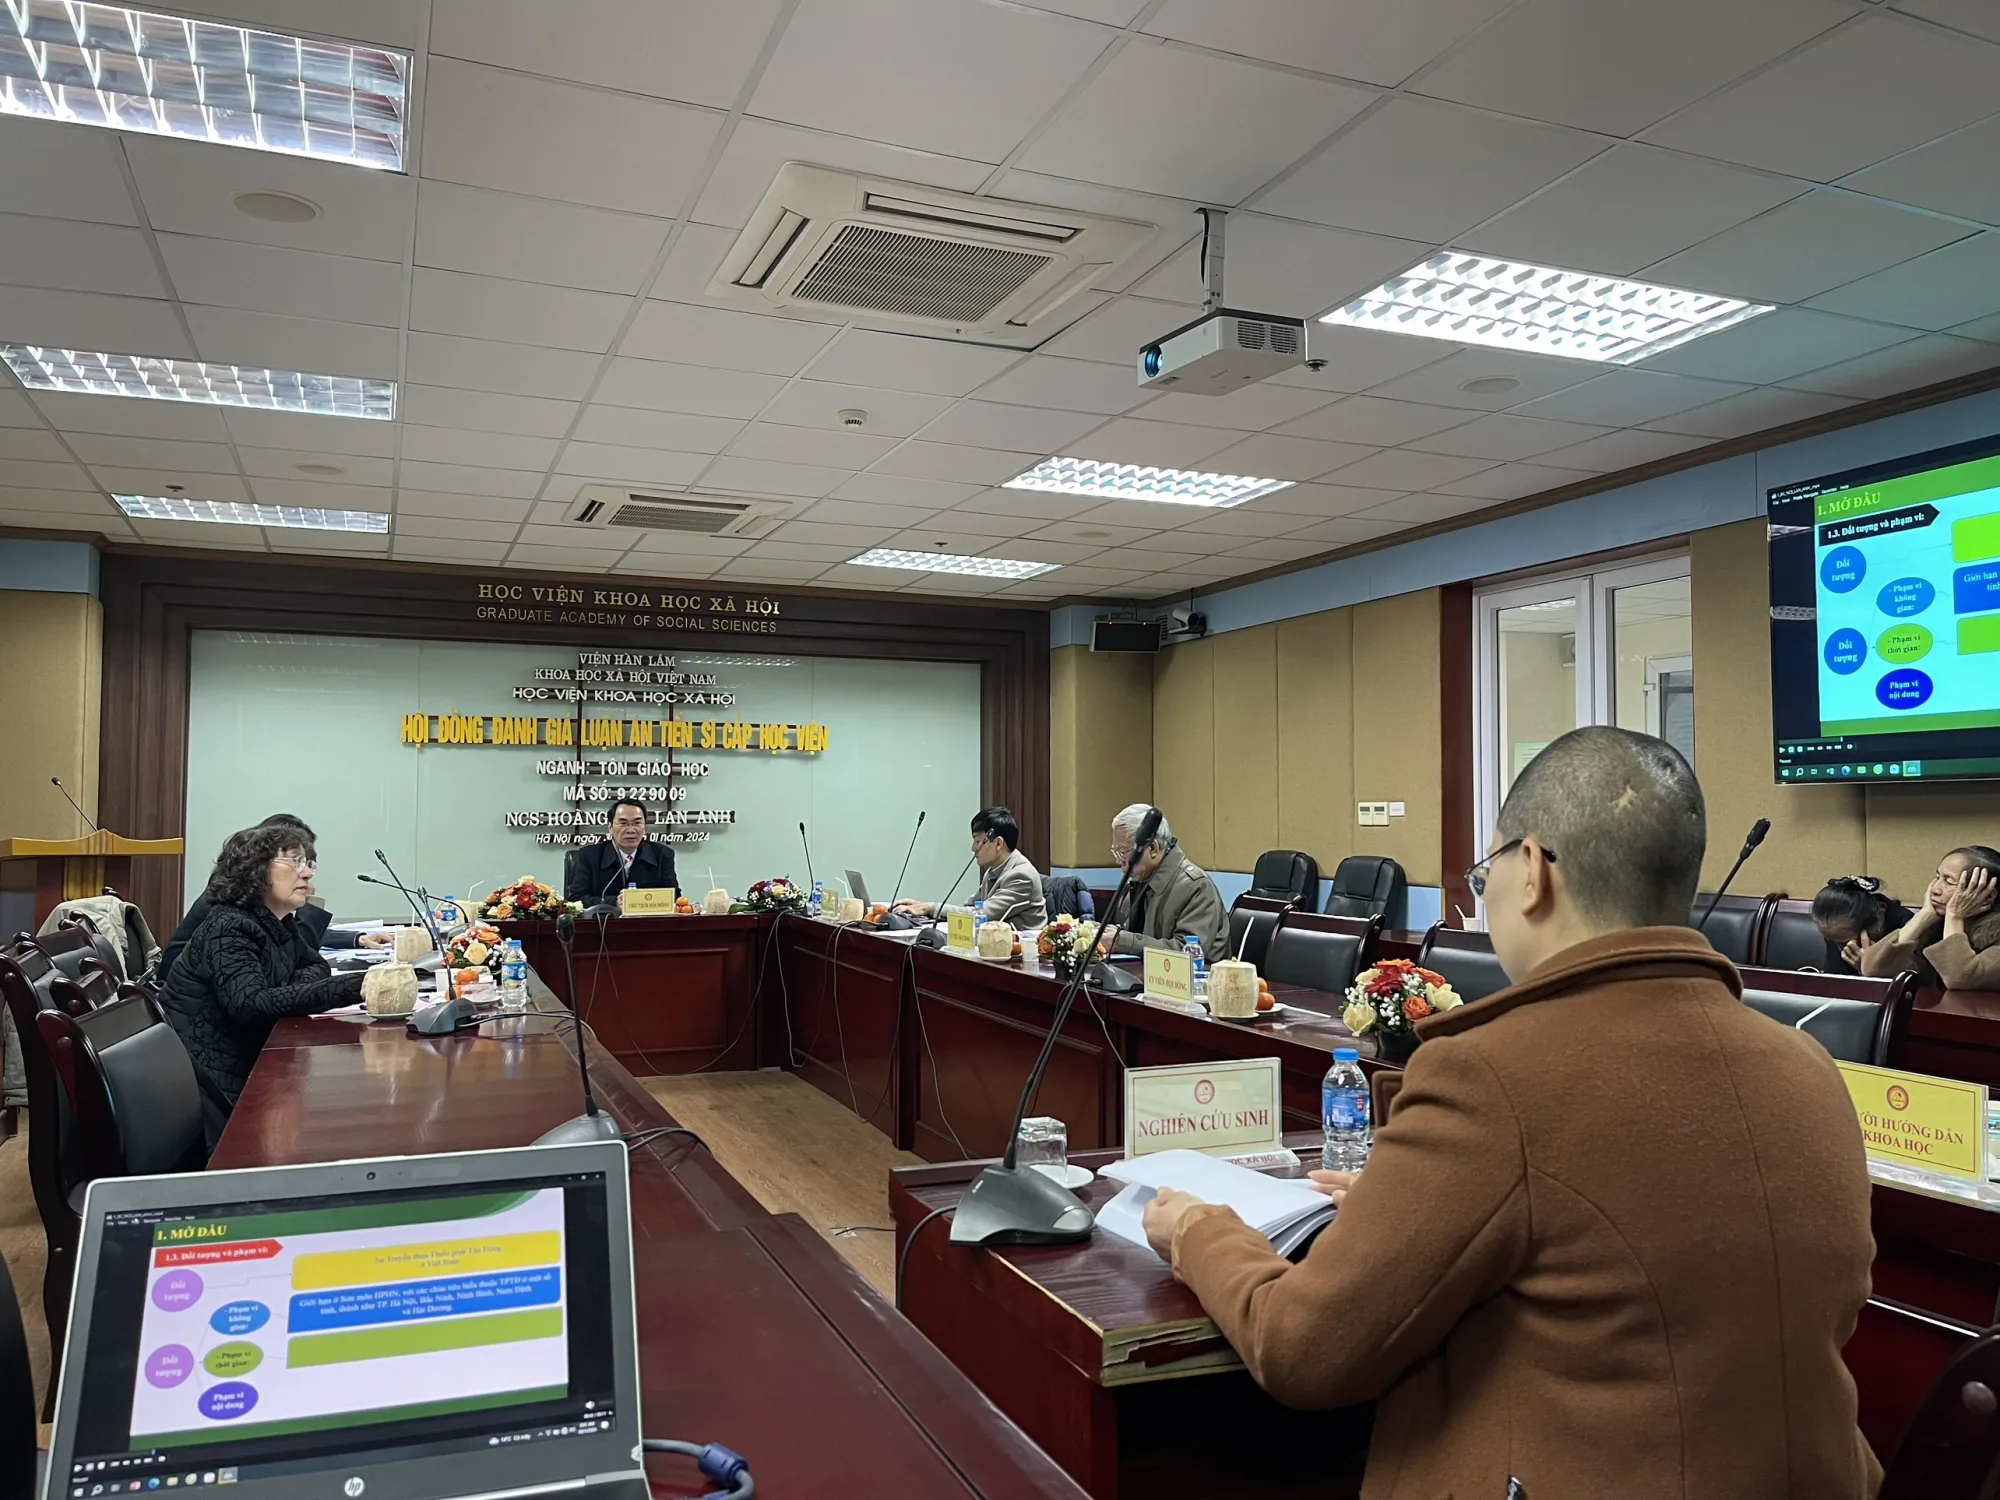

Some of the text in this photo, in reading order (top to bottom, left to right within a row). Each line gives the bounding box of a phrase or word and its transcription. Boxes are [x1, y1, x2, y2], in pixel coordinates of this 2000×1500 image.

[1817, 505, 1826, 516] 1.
[1829, 496, 1851, 513] MỞ
[1853, 491, 1881, 509] ĐẦU
[1828, 529, 1840, 539] 1.3.
[1842, 525, 1855, 536] Đối
[1856, 523, 1879, 533] tượng
[1880, 519, 1889, 528] và
[1890, 517, 1913, 529] phạm
[1836, 558, 1850, 569] Đối
[1831, 572, 1856, 582] tượng
[1963, 571, 1998, 583] Giới hạn
[1893, 585, 1914, 593] Phạm
[478, 584, 780, 617] HỌC VIỆN KHOA HỌC XÃ HỘI
[1894, 594, 1917, 603] không
[477, 606, 777, 633] GRADUATE ACADEMY OF SOCIAL SCIENCES
[1838, 639, 1853, 650] Đối
[1892, 636, 1912, 644] Phạm
[579, 652, 676, 667] VIỆN HÀN LÂM
[1833, 654, 1858, 663] tượng
[534, 669, 717, 686] KHOA HỌC XÃ HỘI VIỆT NAM
[1889, 681, 1910, 690] Phạm
[512, 687, 736, 708] HỌC VIỆN KHOA HỌC XÃ HỘI
[1889, 690, 1920, 700] nội dung
[401, 706, 828, 755] HỘI ĐỒNG ĐÁNH GIÁ LUẬN ÁN TIẾN SĨ CẤP HỌC VIỆN
[536, 758, 709, 780] NGÀNH: TÔN GIÁO HỌC
[563, 783, 585, 801] MÃ
[589, 779, 612, 801] SỐ:
[505, 808, 731, 827] NCS: HOÀNG LAN ANH
[536, 833, 551, 844] Hà
[553, 833, 571, 845] Nội
[573, 834, 601, 846] ngày
[659, 833, 684, 842] năm
[685, 832, 710, 842] 2024
[1138, 1109, 1269, 1138] NGHIÊN CỨU SINH
[1881, 1117, 1964, 1145] HƯỚNG DẪN
[1863, 1130, 1934, 1156] KHOA HỌC
[157, 1224, 228, 1241] 1. MỞ ĐẦU
[181, 1251, 195, 1261] Đối
[197, 1250, 221, 1260] tượng
[222, 1248, 232, 1257] và
[233, 1247, 256, 1258] phạm
[348, 1478, 361, 1496] hp
